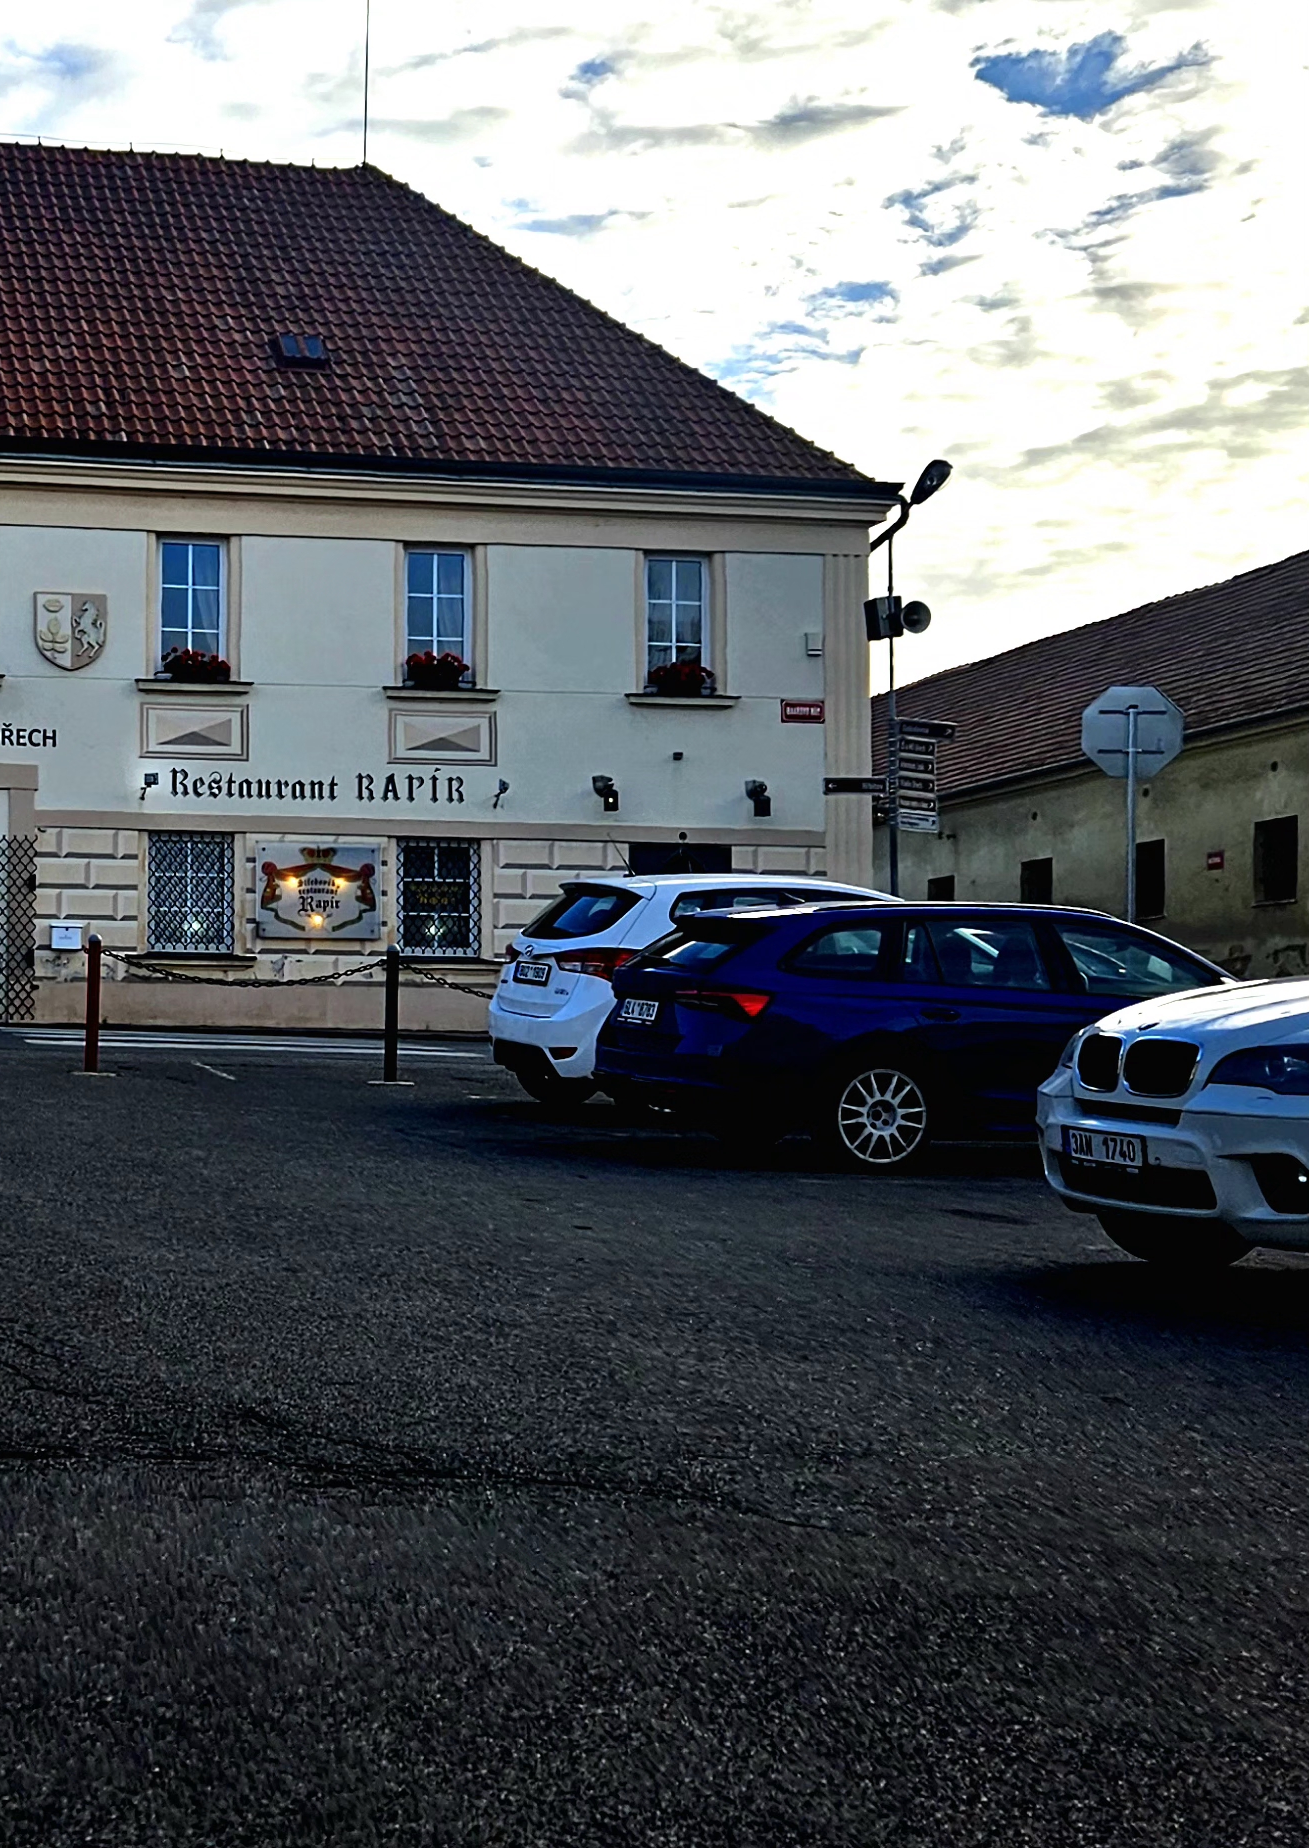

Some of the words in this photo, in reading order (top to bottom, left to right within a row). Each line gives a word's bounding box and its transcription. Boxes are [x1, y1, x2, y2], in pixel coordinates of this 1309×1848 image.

[169, 767, 339, 801] Restaurant
[355, 767, 466, 805] RAPÍR
[1071, 1132, 1094, 1158] 3AN
[1102, 1136, 1137, 1163] 1740
